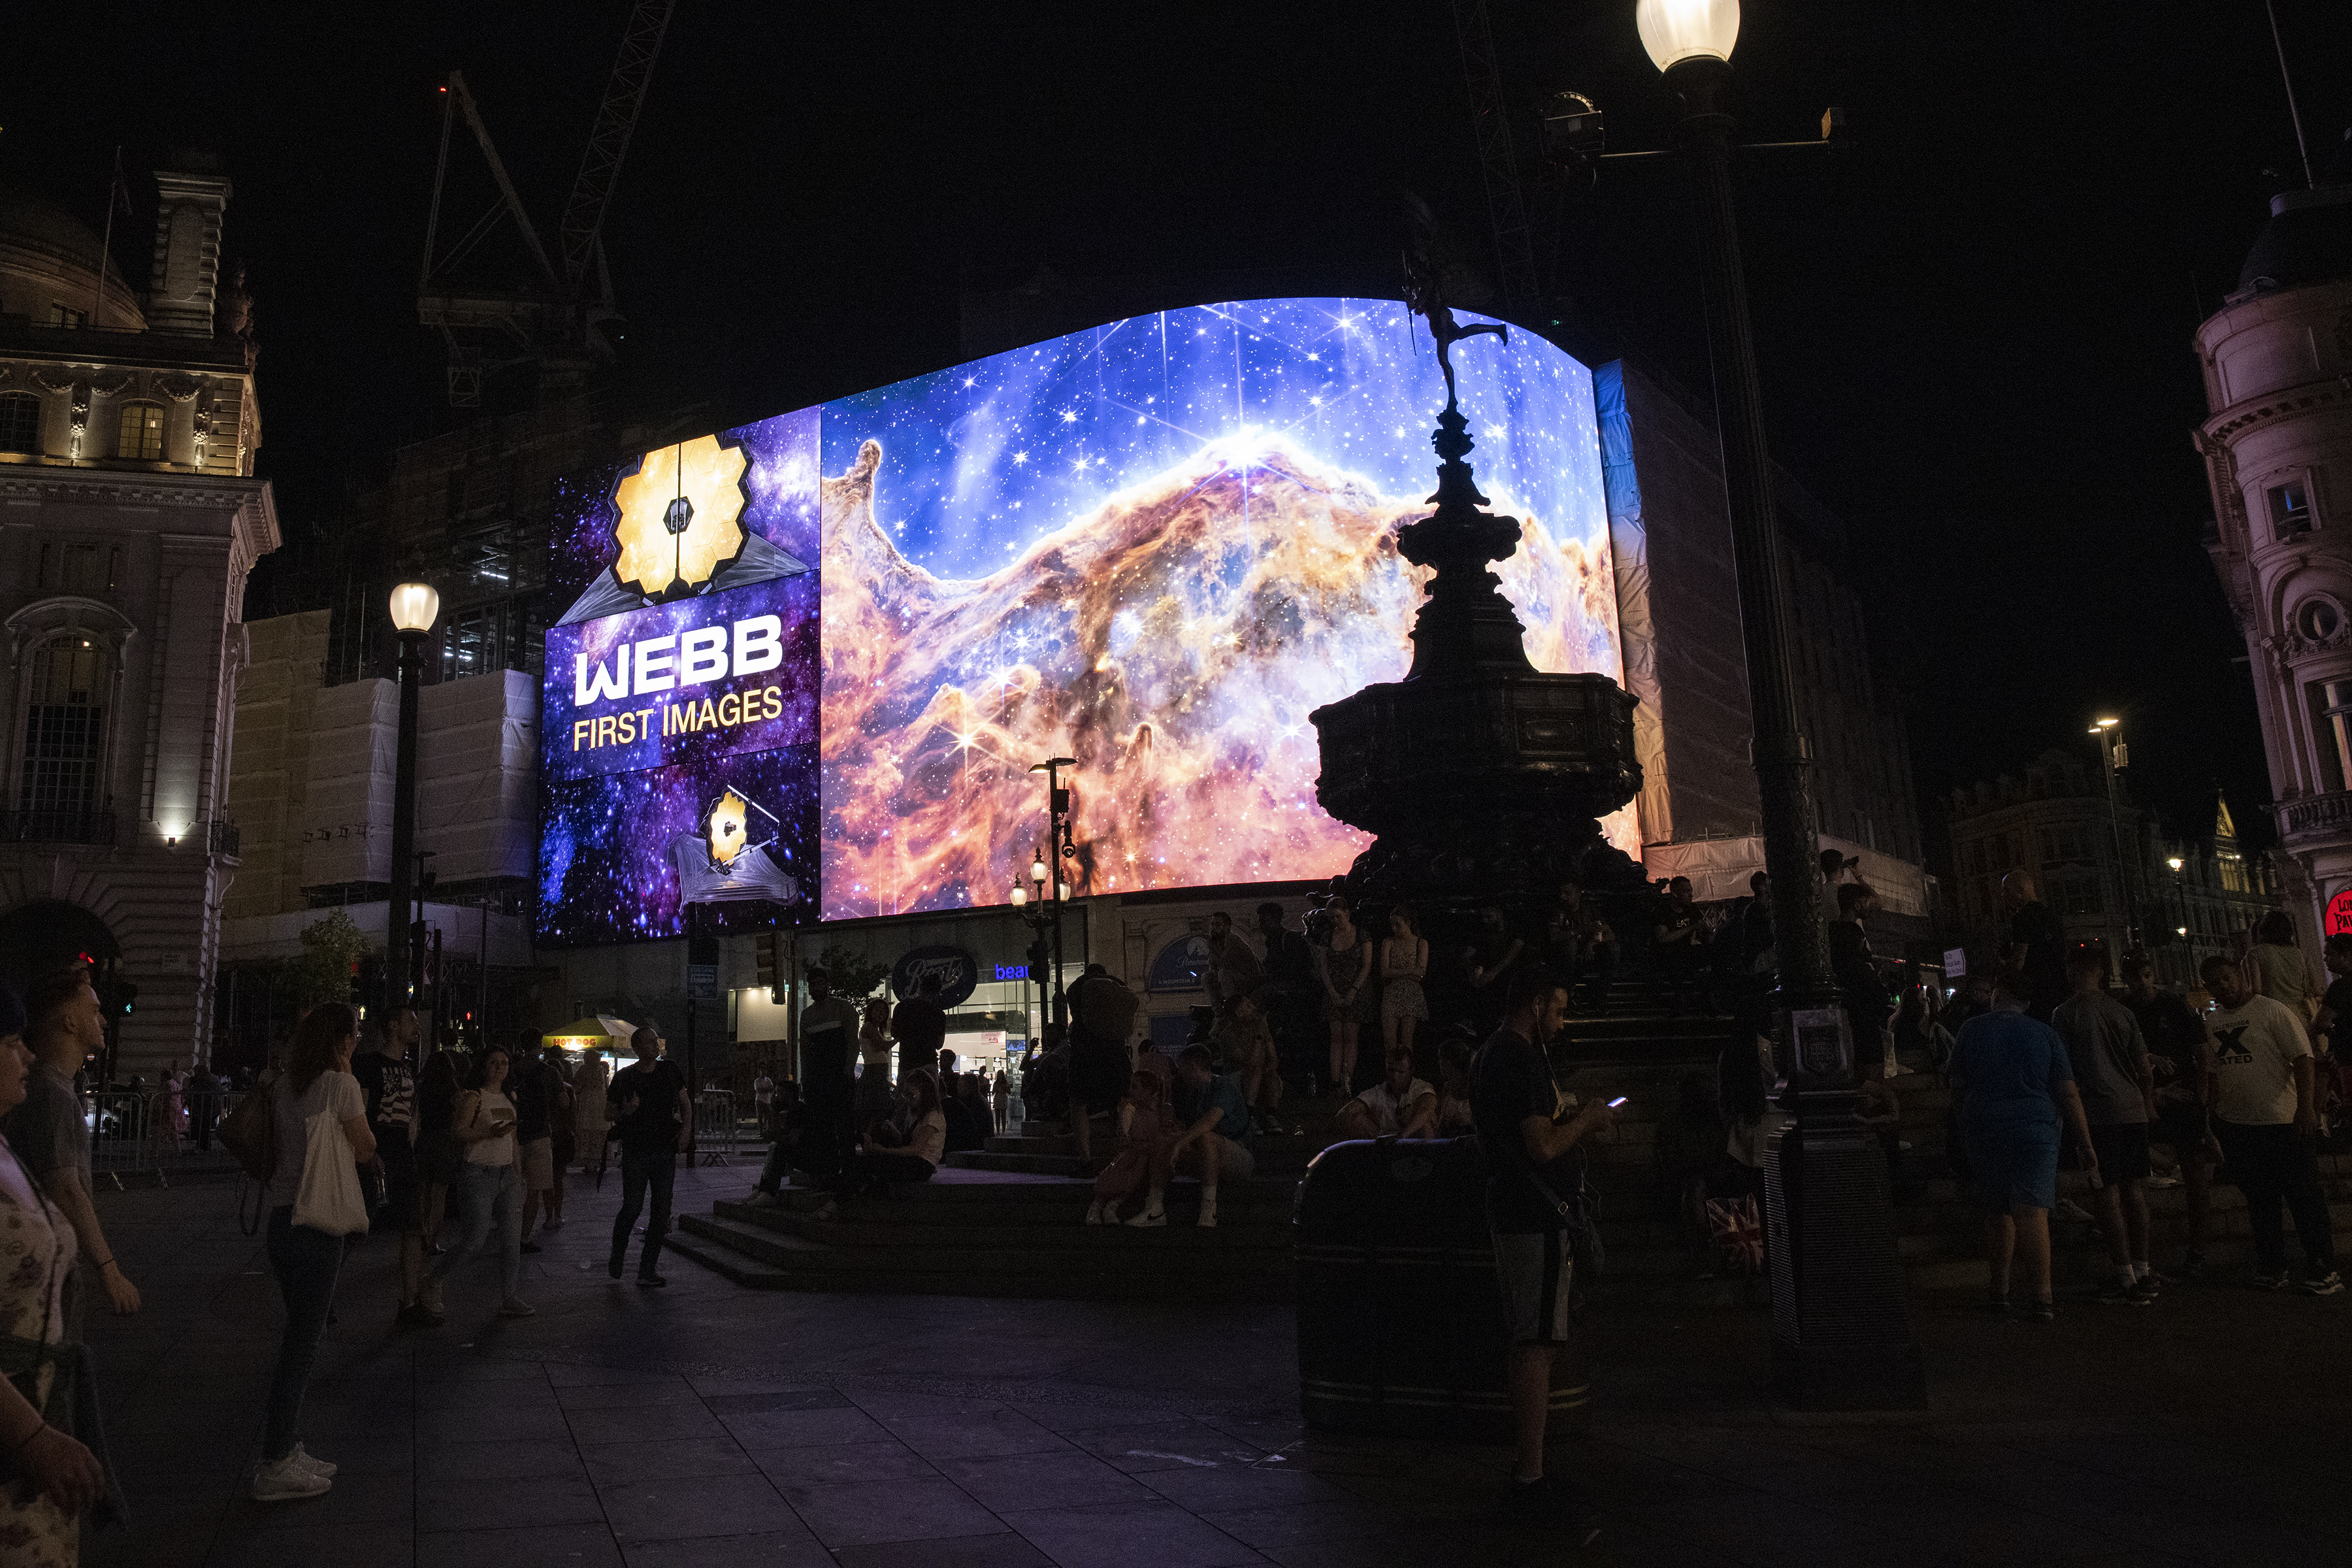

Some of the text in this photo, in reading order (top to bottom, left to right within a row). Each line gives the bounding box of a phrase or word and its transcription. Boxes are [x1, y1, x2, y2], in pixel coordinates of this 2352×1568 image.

[575, 614, 783, 706] WEBB
[574, 686, 782, 751] FIRST IMAGES
[1676, 917, 1690, 928] EA7
[900, 956, 964, 1000] Boots
[2213, 1026, 2251, 1057] X
[2219, 1055, 2253, 1065] ATED
